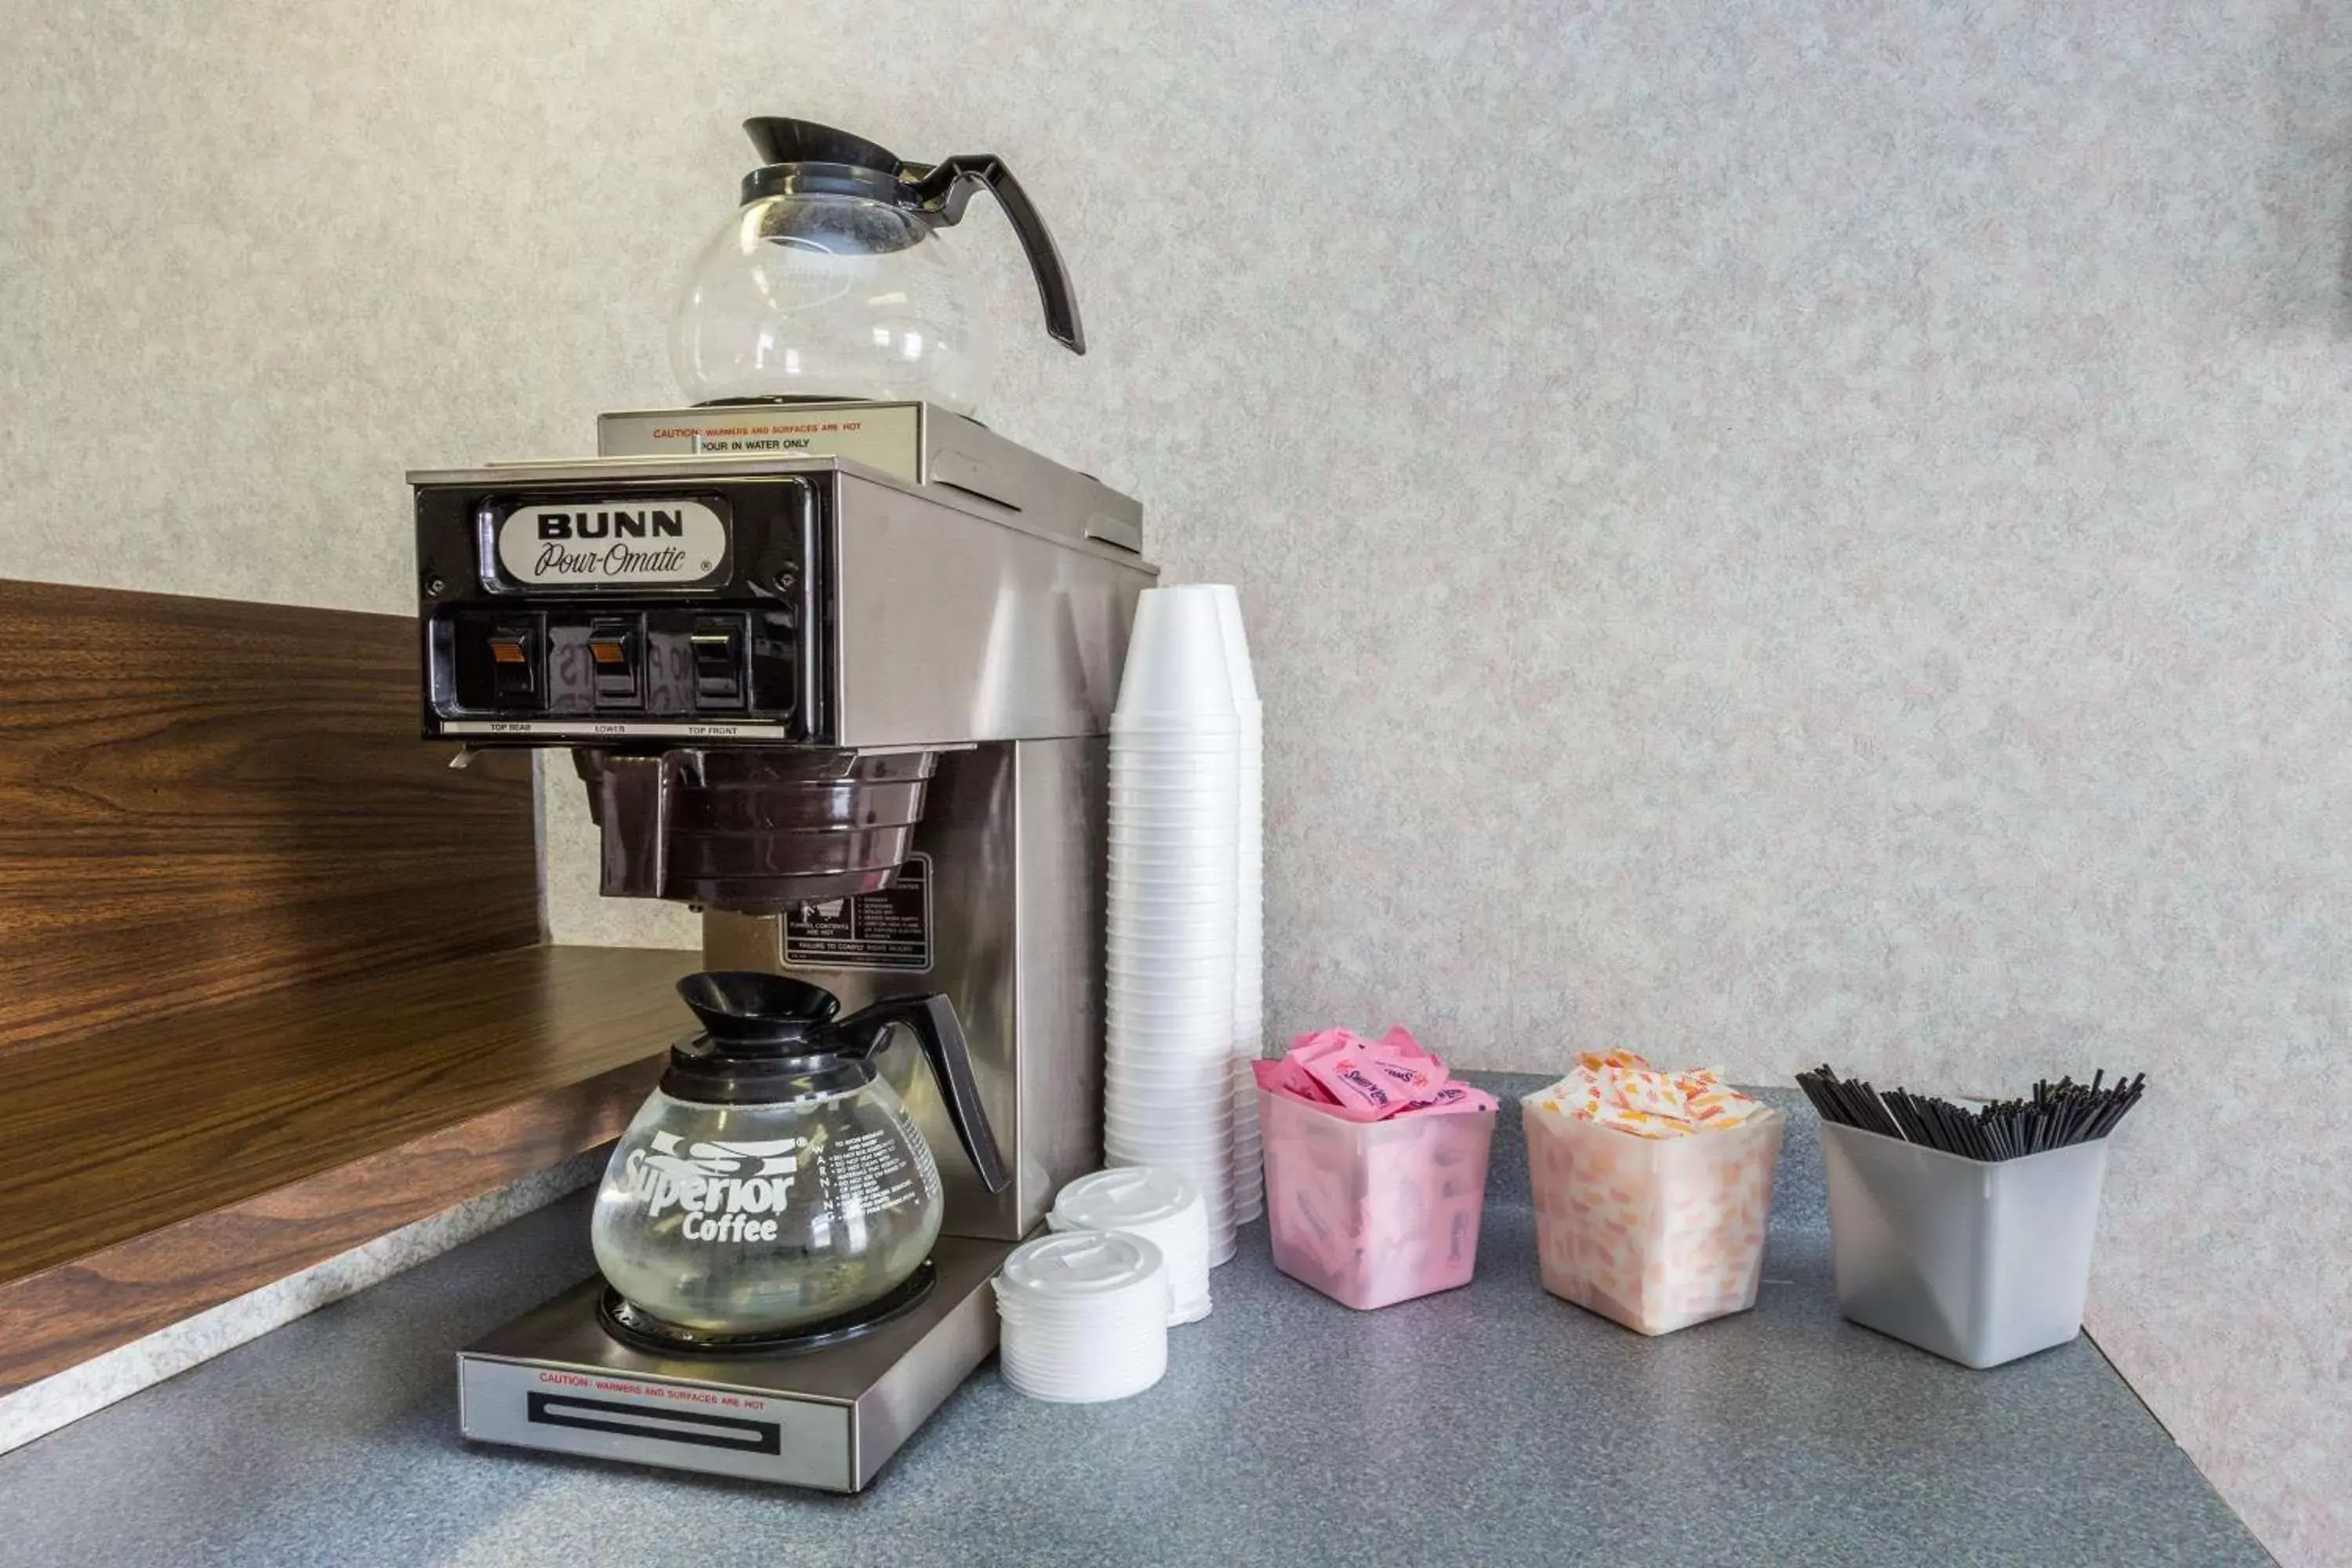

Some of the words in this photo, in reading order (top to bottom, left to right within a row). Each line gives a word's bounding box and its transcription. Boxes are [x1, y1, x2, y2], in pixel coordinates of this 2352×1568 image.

[706, 426, 748, 437] WARMERS
[750, 426, 768, 435] AND
[771, 424, 817, 434] SURFACES
[731, 441, 742, 450] IN
[746, 440, 780, 449] WATER
[782, 438, 810, 448] ONLY
[537, 510, 683, 539] BUNN
[535, 542, 686, 576] Pour-Omatic
[595, 725, 625, 734] LOWER
[689, 727, 706, 735] TOP
[708, 727, 738, 735] FRONT
[627, 1149, 795, 1217] Superior
[682, 1211, 779, 1243] Coffee
[539, 1372, 591, 1387] CAUTION:
[596, 1380, 642, 1395] WARMERS
[644, 1386, 665, 1397] AND
[667, 1390, 717, 1404] SURFACES
[720, 1396, 740, 1407] ARE
[744, 1399, 764, 1410] HOT
